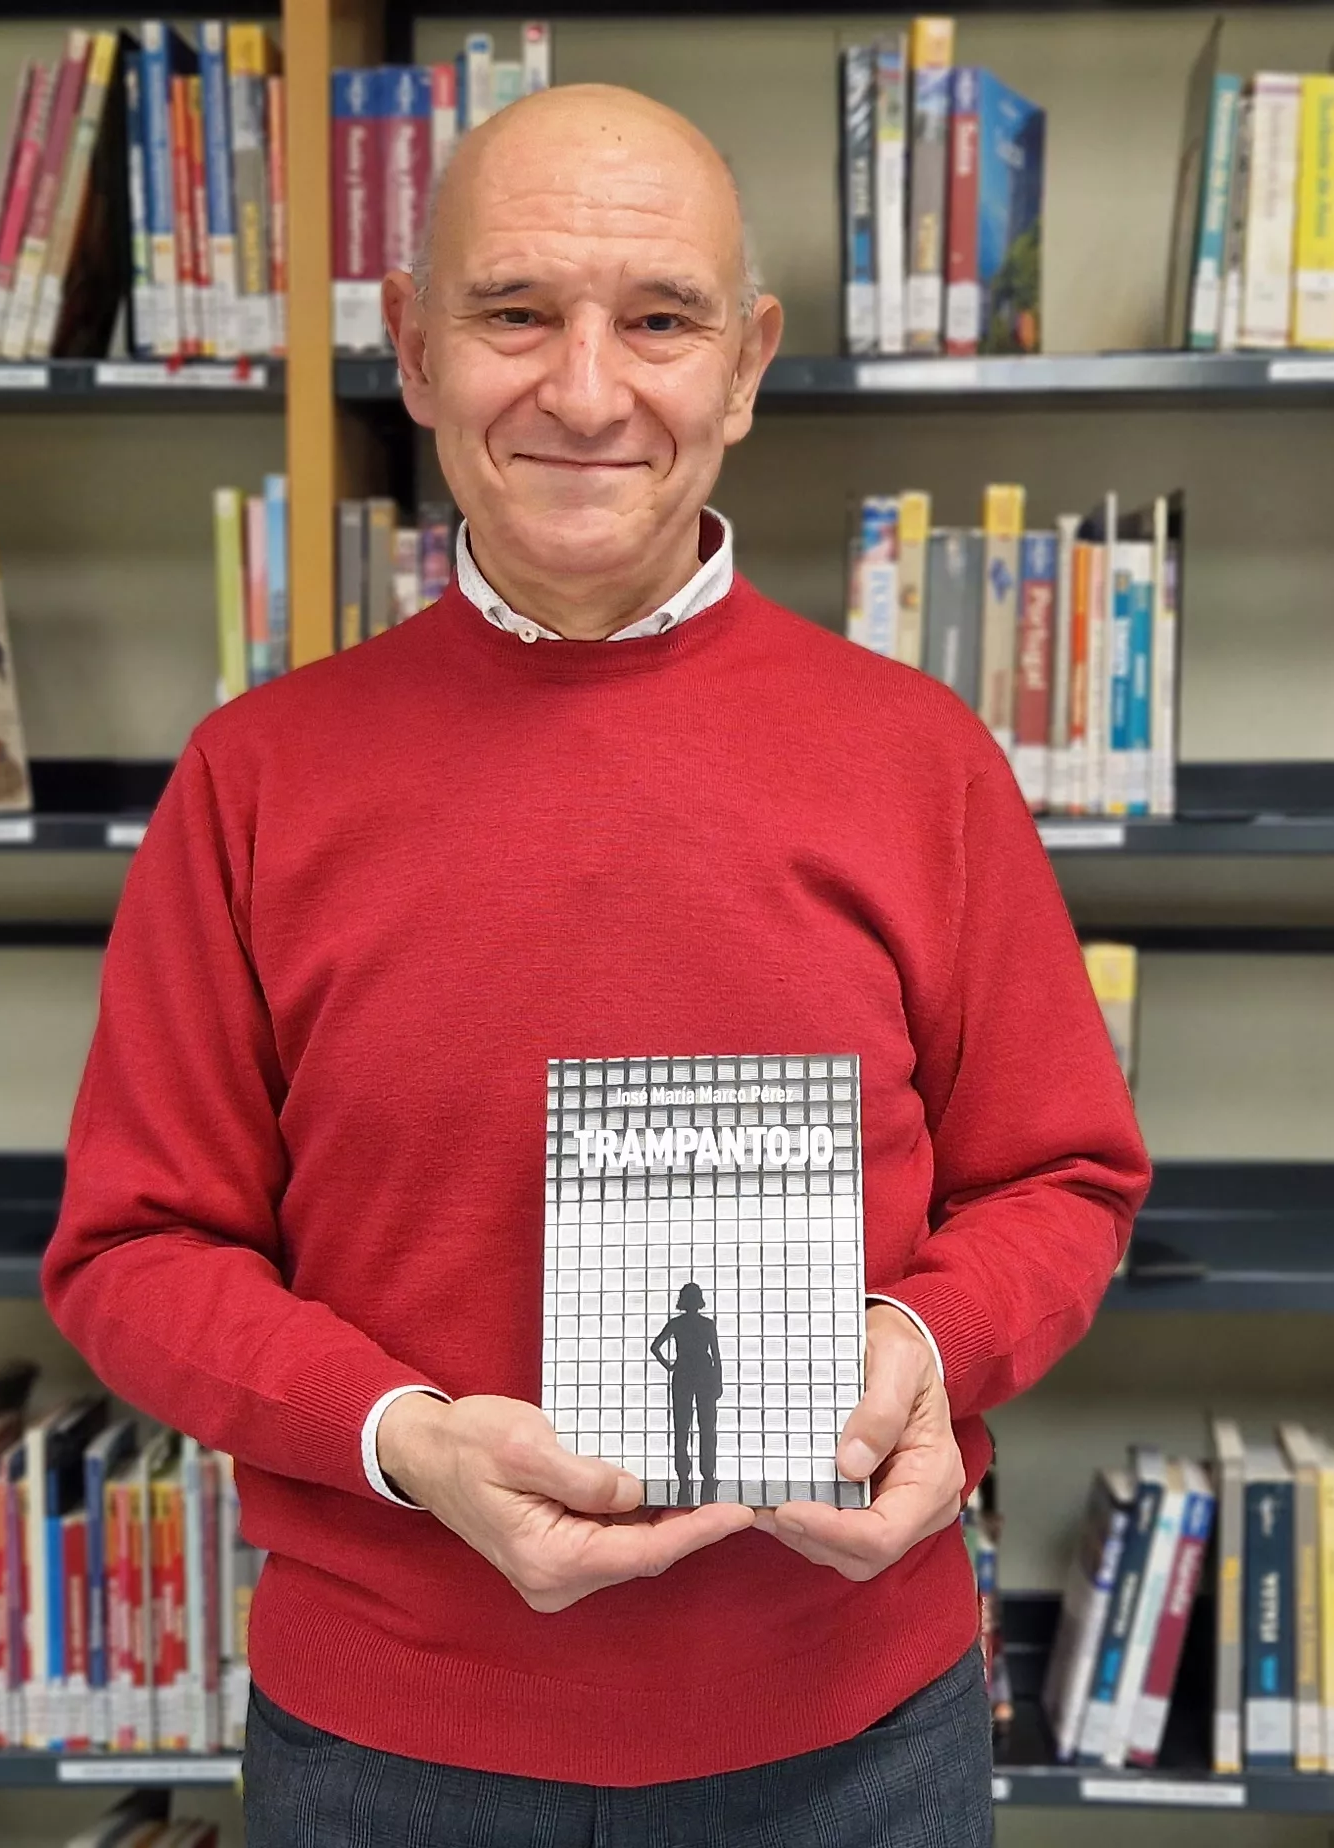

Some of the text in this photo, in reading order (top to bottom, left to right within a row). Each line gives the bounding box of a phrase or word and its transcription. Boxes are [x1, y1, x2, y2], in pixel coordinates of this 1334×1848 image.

[1023, 587, 1051, 691] Portugal
[614, 1084, 794, 1106] José María Marco Pérez
[574, 1125, 834, 1168] TRAMPANTOJO
